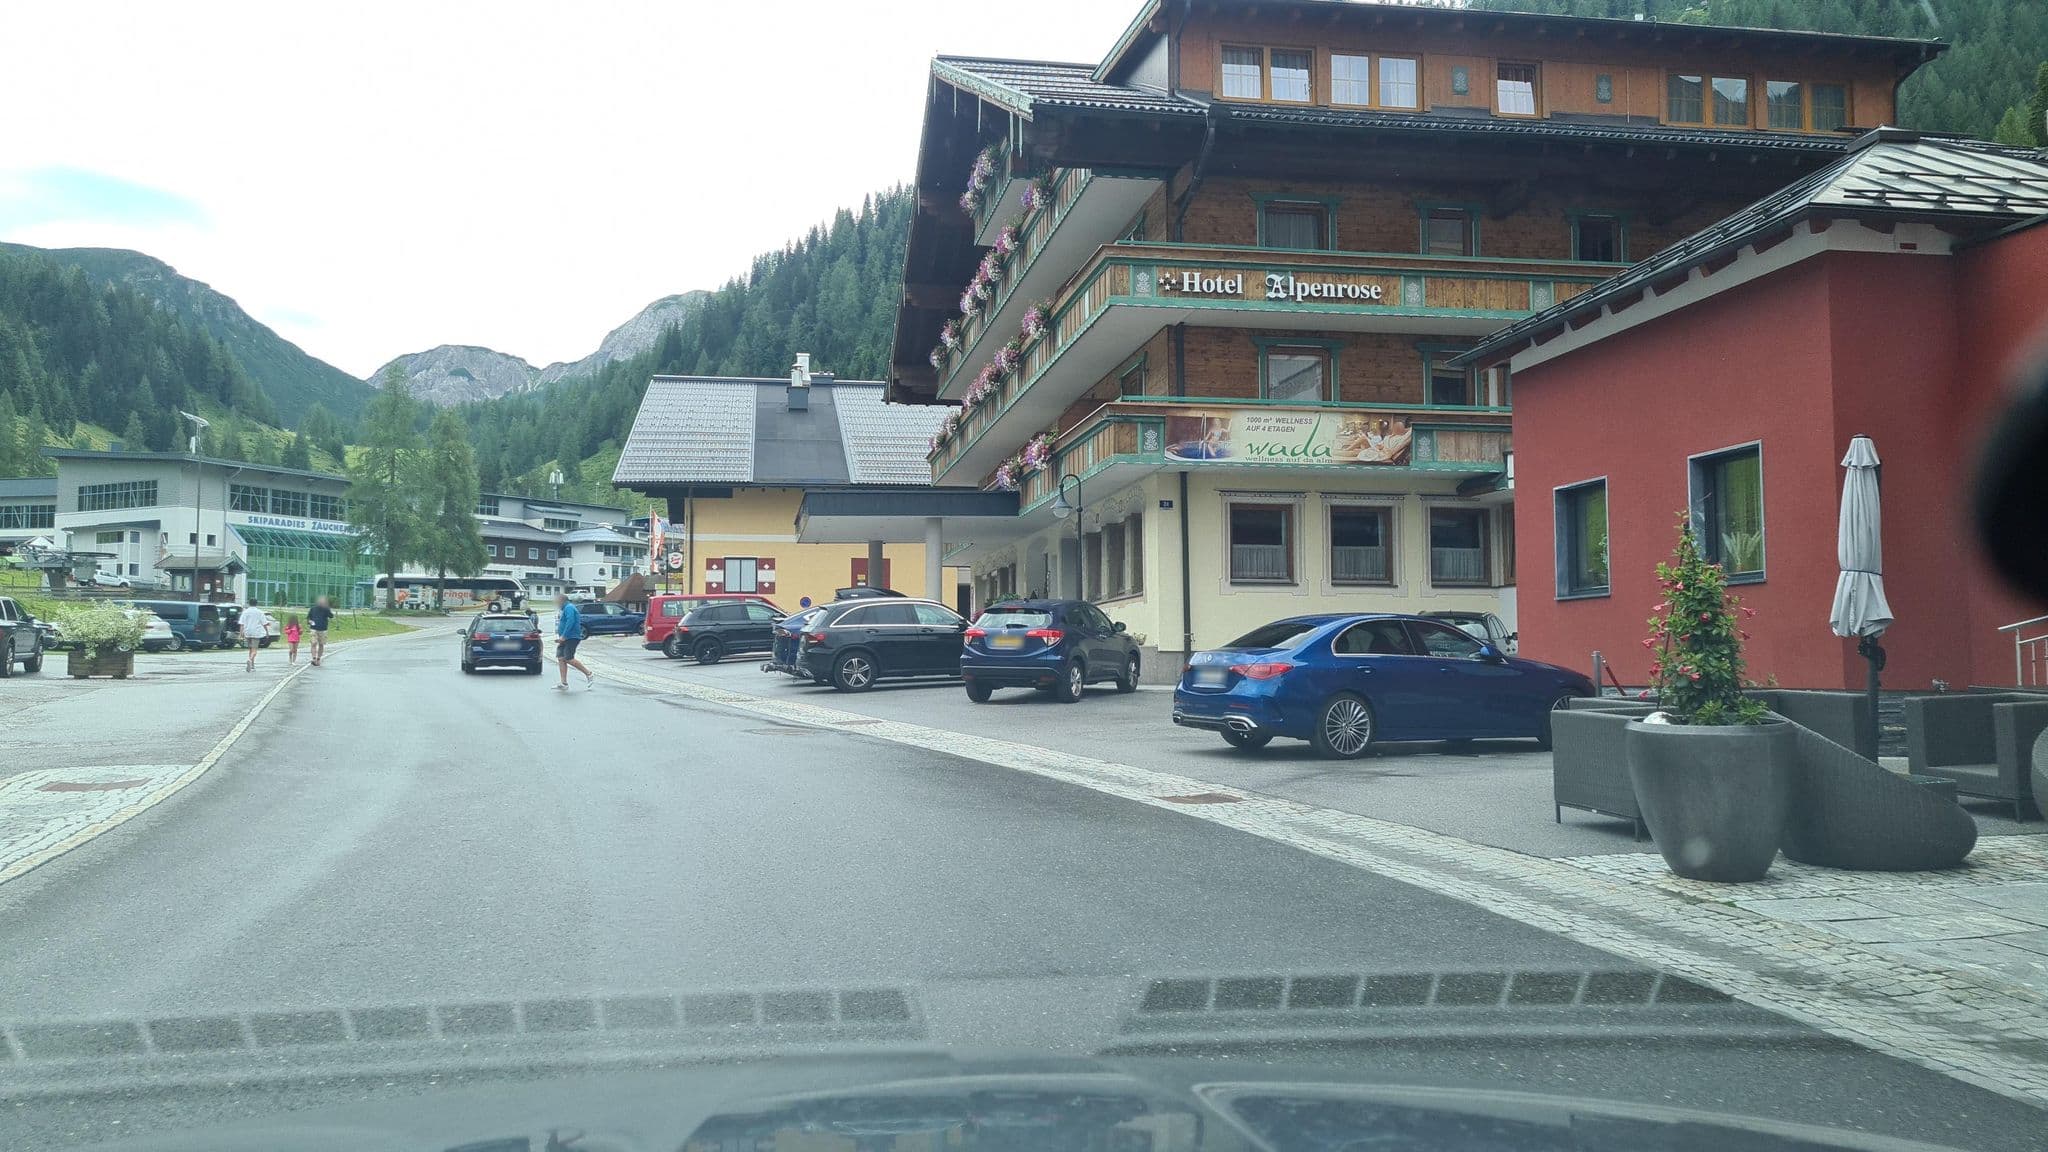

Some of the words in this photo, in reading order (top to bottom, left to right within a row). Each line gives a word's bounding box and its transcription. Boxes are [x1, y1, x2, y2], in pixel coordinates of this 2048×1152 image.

[1181, 271, 1243, 295] Hotel
[1265, 273, 1382, 302] Alpenrose
[1267, 425, 1296, 433] ETAGEN
[1275, 417, 1313, 425] WELLNESS
[1245, 413, 1333, 458] wada
[248, 515, 306, 529] SKIPARADIES
[311, 520, 361, 534] ZAUCHEN
